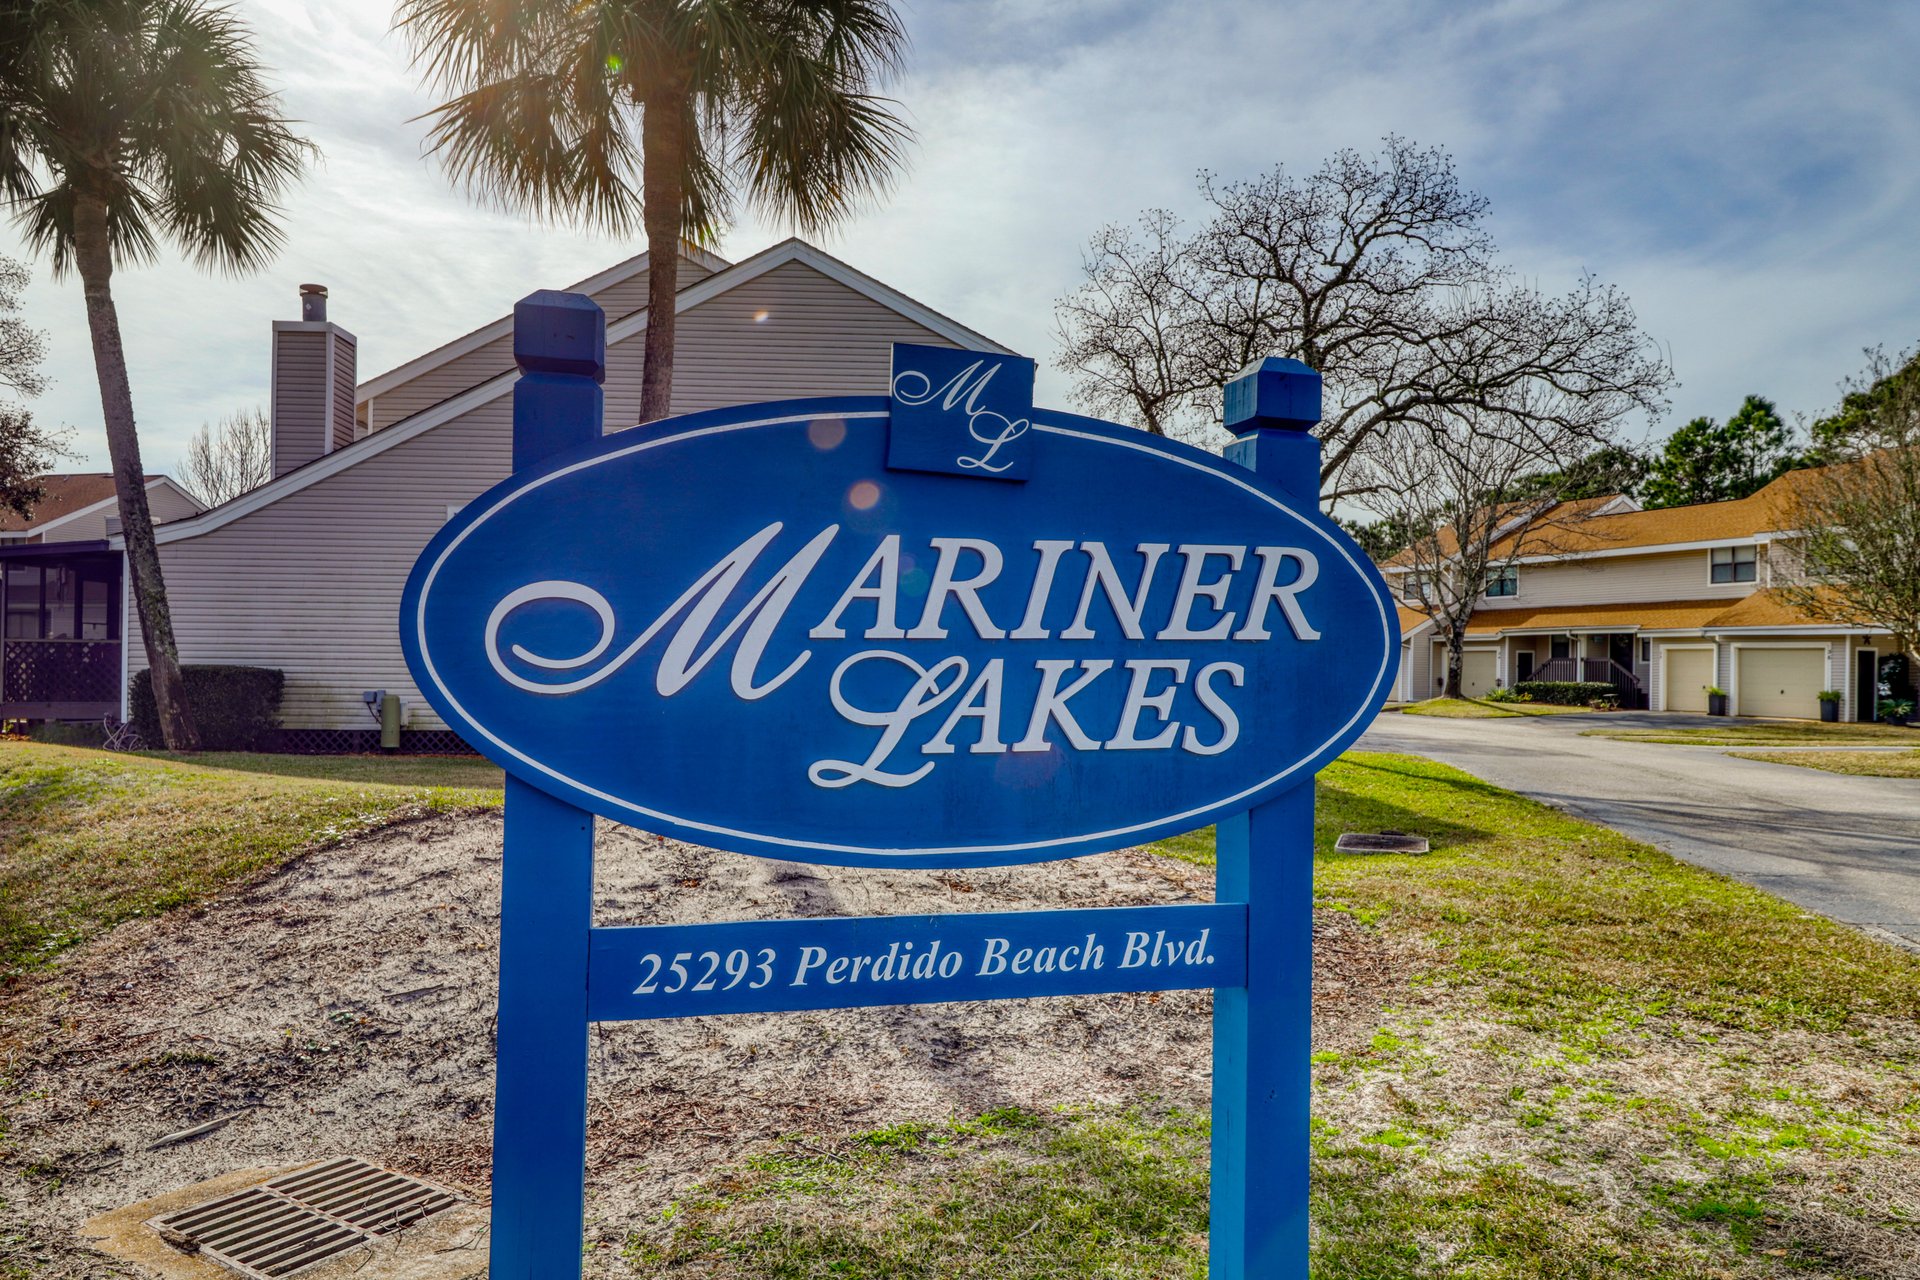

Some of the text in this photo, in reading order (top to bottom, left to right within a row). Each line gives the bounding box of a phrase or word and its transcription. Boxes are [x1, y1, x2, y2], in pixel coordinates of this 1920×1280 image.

[484, 521, 1322, 700] MARINER
[808, 649, 1245, 788] LAKES
[632, 928, 1215, 995] 25293 Perdido Beach Blvd.
